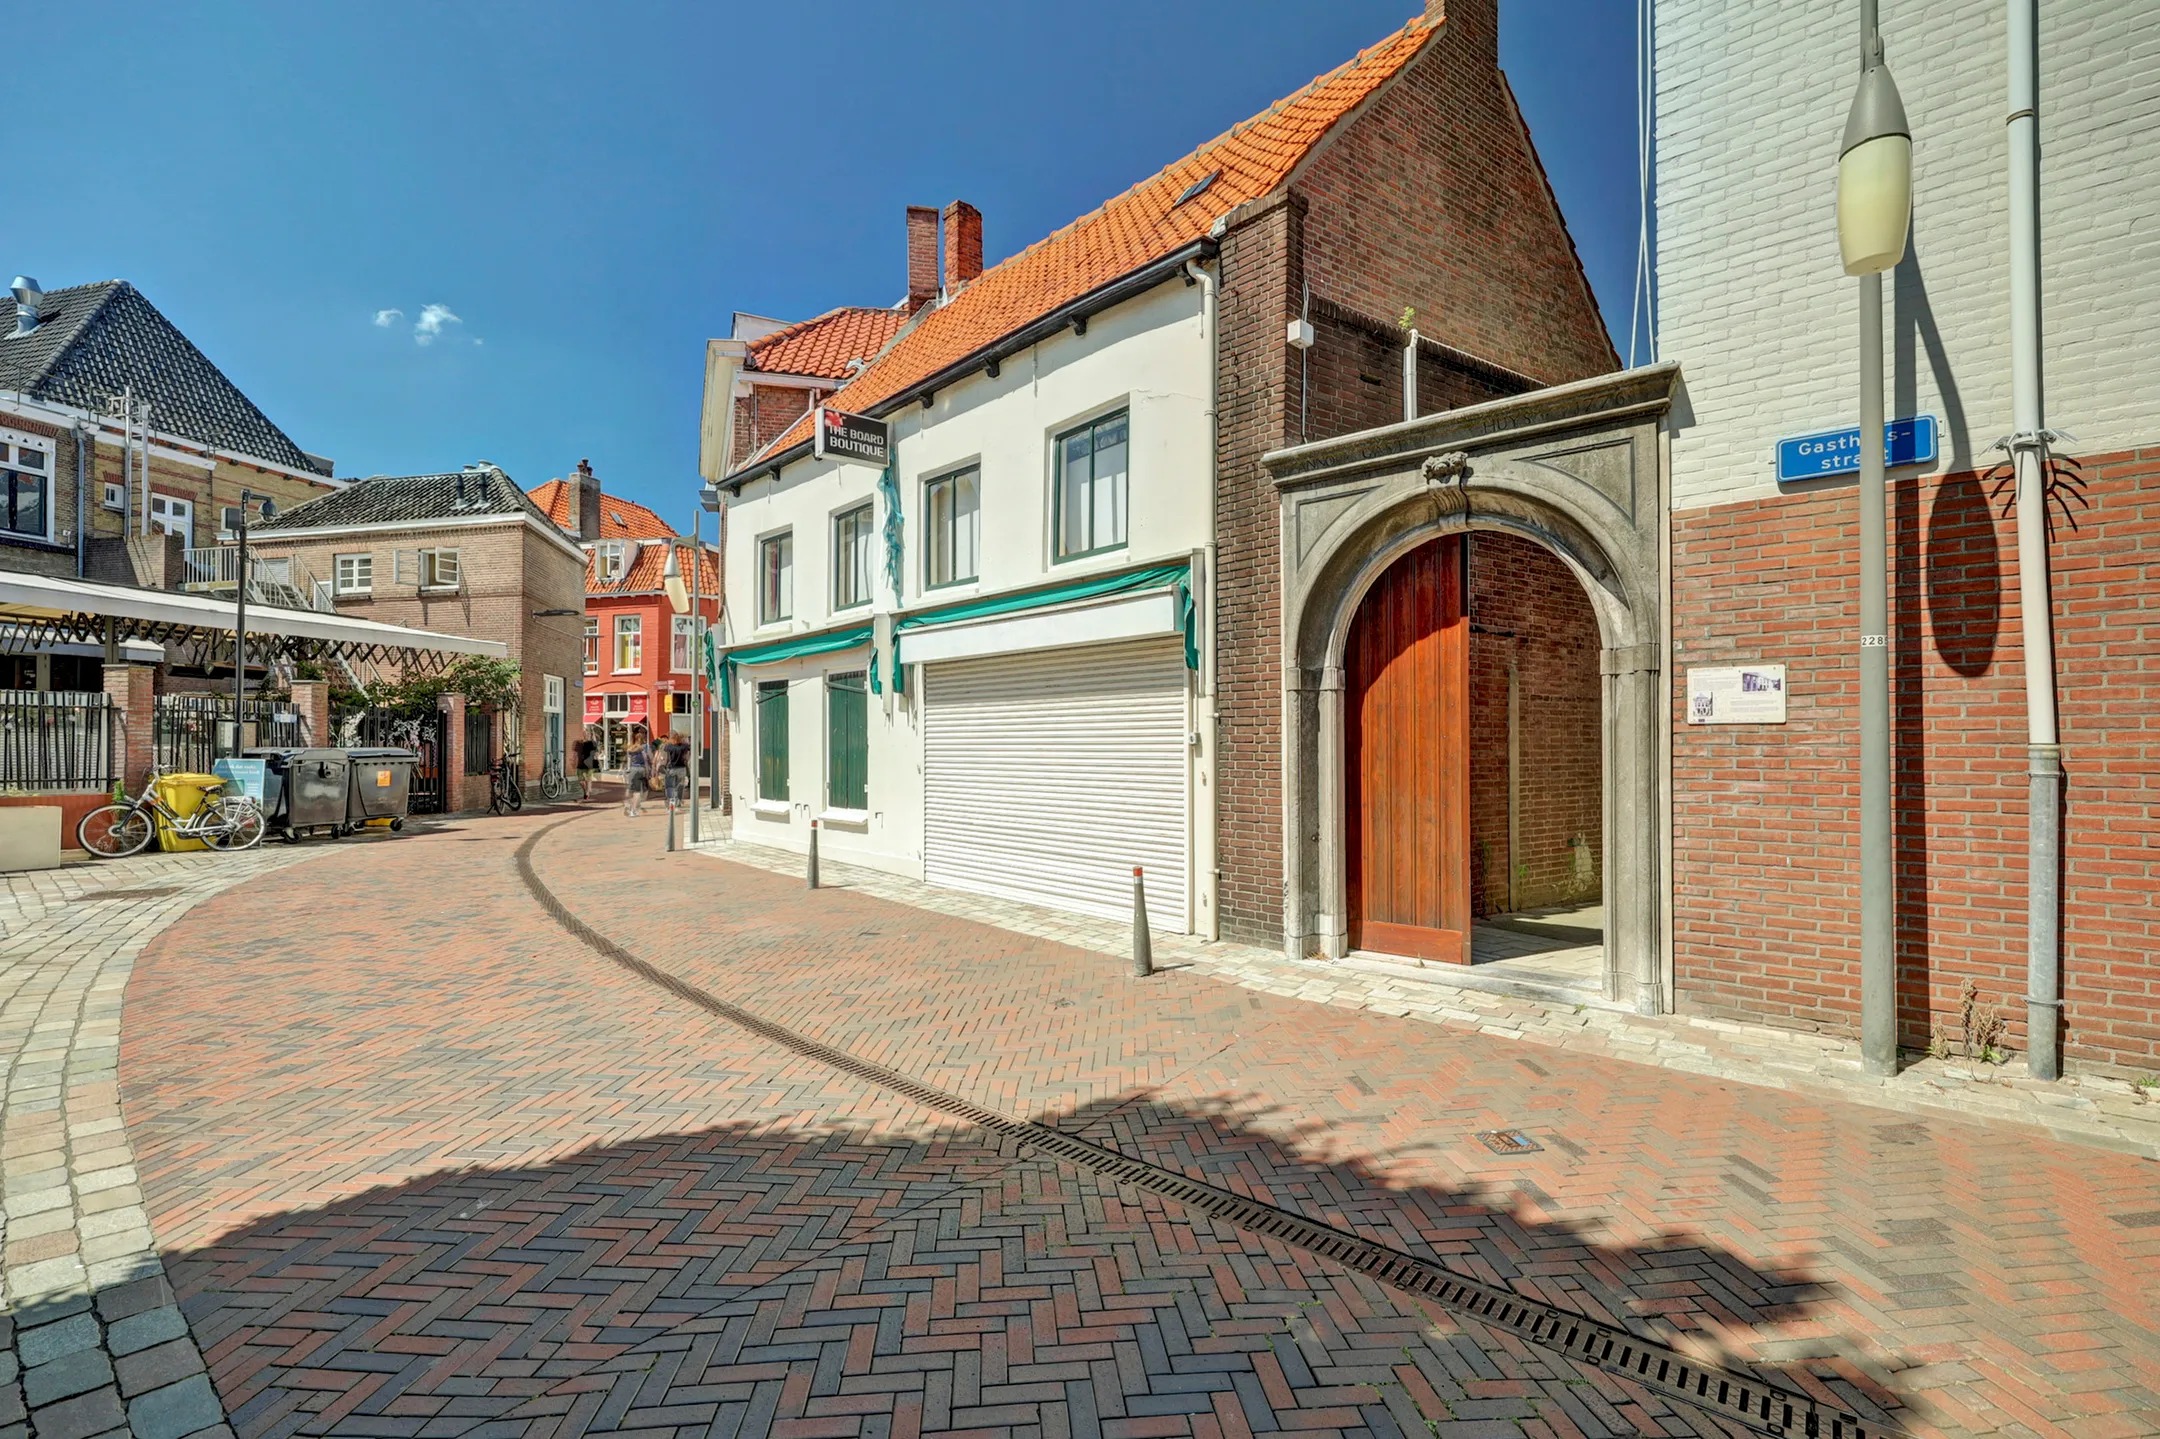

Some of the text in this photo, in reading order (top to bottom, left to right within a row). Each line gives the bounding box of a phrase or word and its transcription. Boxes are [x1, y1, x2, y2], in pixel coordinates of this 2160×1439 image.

[830, 425, 884, 445] THE BOARD
[1799, 431, 1911, 456] Gasths-
[830, 436, 884, 457] BOUTIQUE
[1821, 447, 1889, 469] strat
